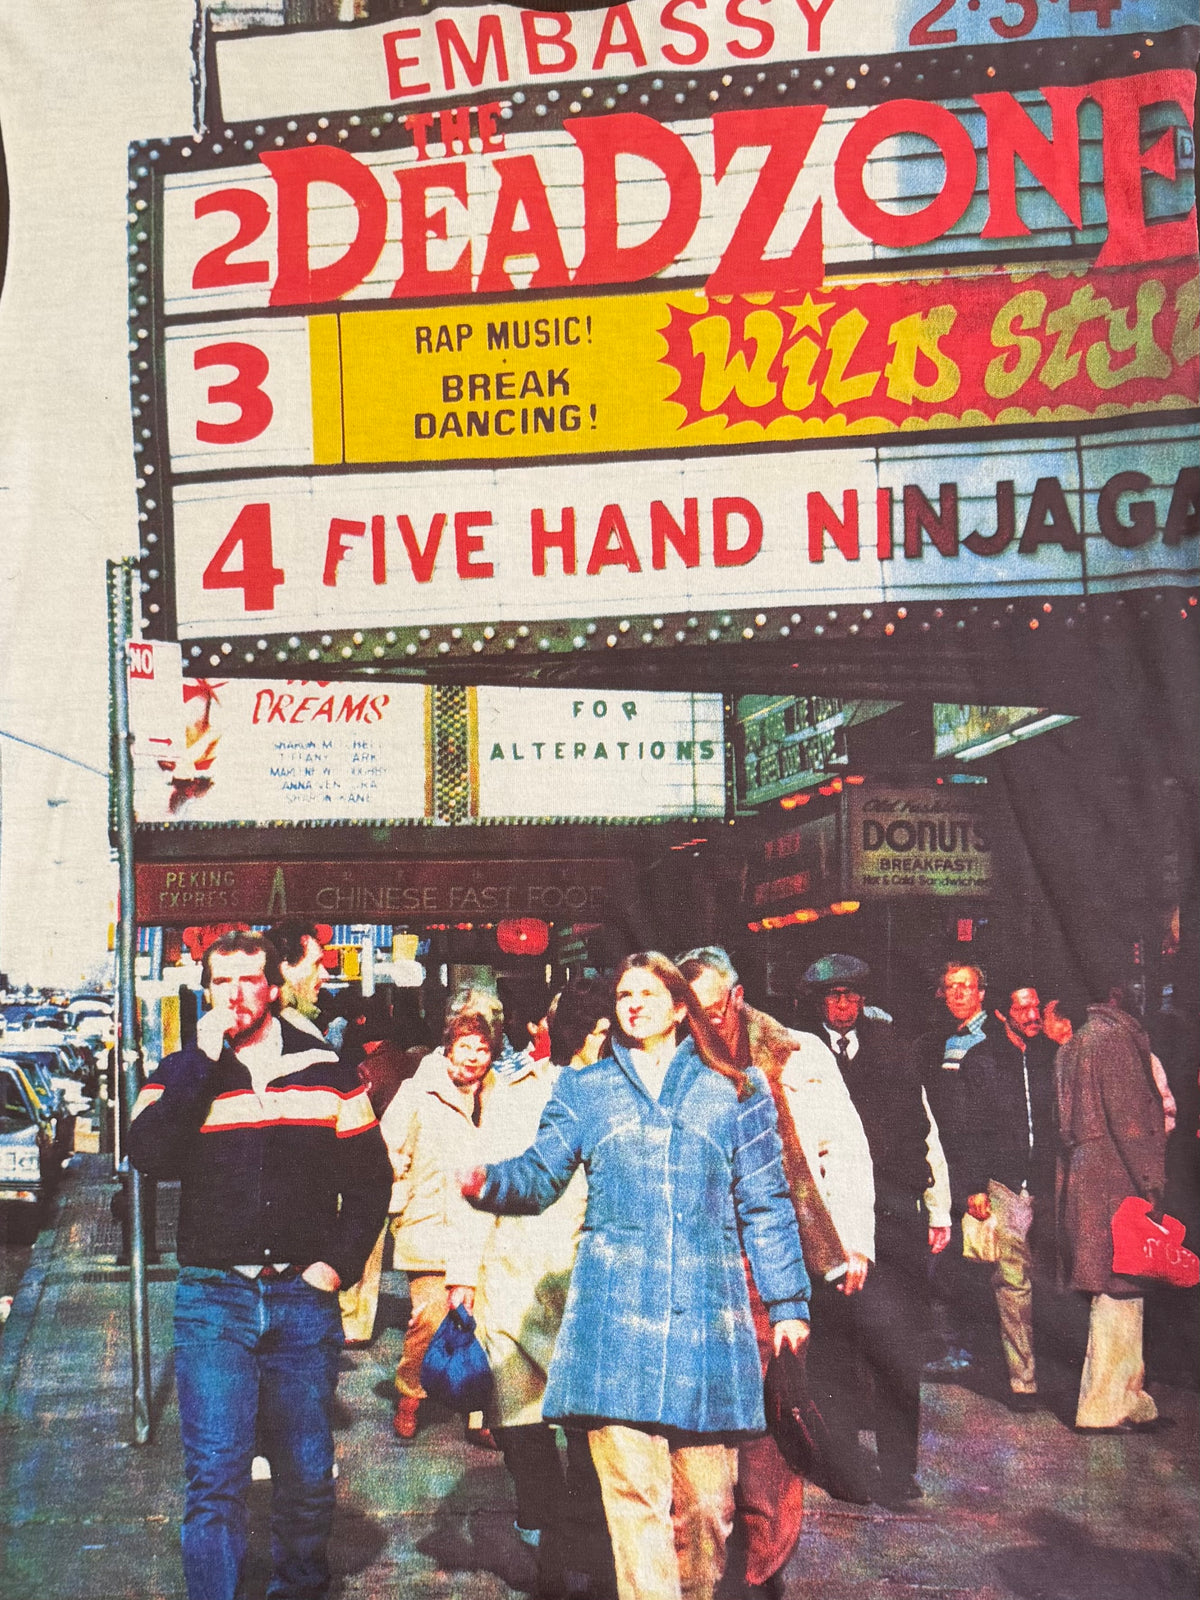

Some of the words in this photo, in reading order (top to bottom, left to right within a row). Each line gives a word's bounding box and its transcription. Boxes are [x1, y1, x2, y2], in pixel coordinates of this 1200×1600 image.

[382, 0, 834, 100] EMBASSY
[403, 101, 507, 162] THE
[192, 188, 271, 290] 2
[260, 112, 702, 307] DEAD
[703, 68, 1198, 297] ZONE
[415, 324, 473, 354] RAP
[487, 315, 594, 350] MUSIC!
[194, 341, 274, 445] 3
[442, 368, 571, 403] BREAK
[413, 403, 598, 440] DANCING!
[202, 503, 285, 612] 4
[322, 510, 494, 586] FIVE
[531, 496, 764, 576] HAND
[130, 648, 153, 674] NO
[252, 689, 390, 725] DREAMS
[572, 700, 638, 720] FOR
[490, 741, 716, 761] ALTERATIONS
[166, 870, 236, 889] PEKING
[880, 858, 974, 872] BREAKFAST
[159, 890, 242, 909] EXPRESS
[316, 886, 438, 910] CHINESE
[449, 886, 519, 910] FAST
